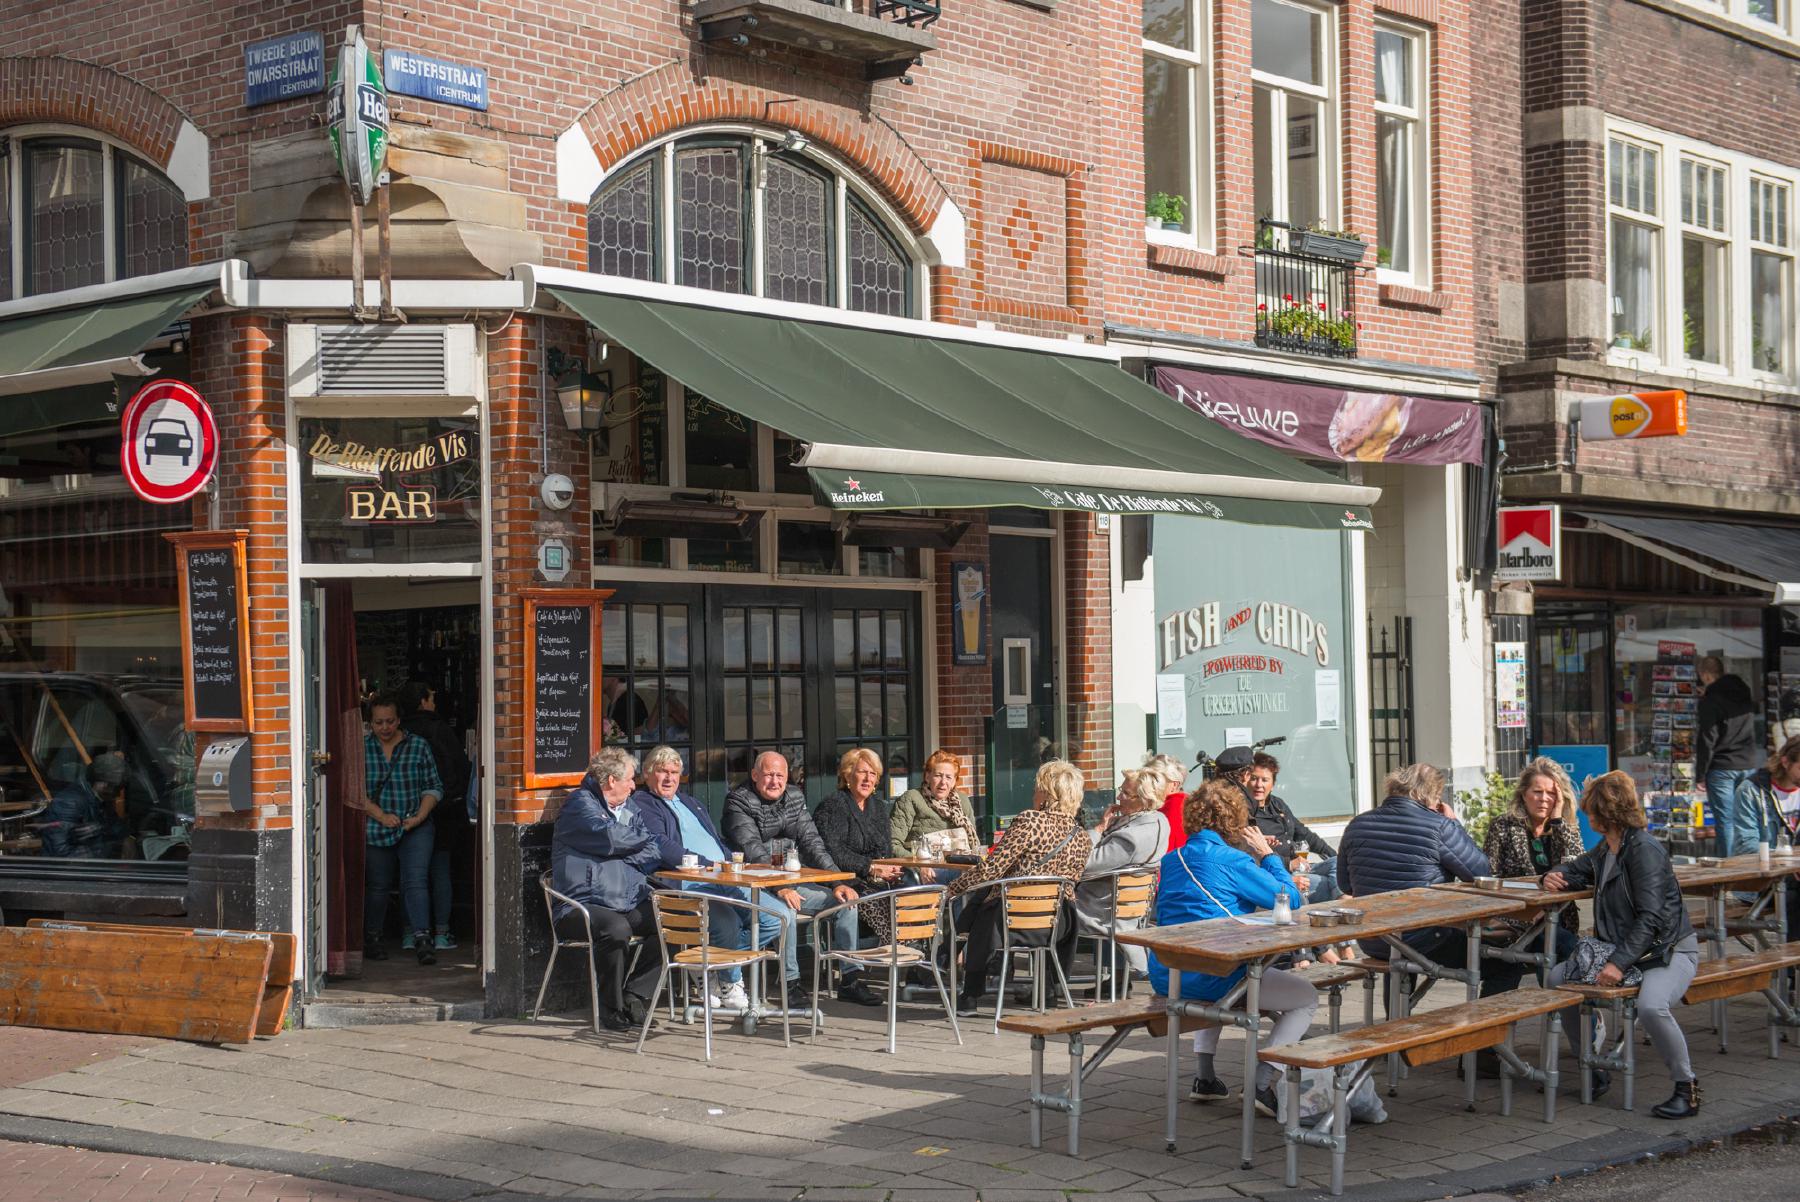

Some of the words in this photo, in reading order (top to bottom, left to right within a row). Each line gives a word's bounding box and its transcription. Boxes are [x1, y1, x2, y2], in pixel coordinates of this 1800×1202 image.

[248, 43, 286, 66] TWEEDE
[290, 36, 320, 56] BOOM
[248, 56, 320, 86] DWARSSTRAAT
[390, 54, 483, 89] WESTERSTRAAT
[1175, 384, 1299, 437] Nieuwe
[308, 433, 340, 459] De
[337, 441, 436, 472] Blaffende
[439, 433, 468, 463] Vis
[350, 491, 435, 520] BAR
[830, 490, 885, 503] Heineken
[1097, 493, 1124, 511] De
[1499, 546, 1553, 568] Marlboro
[1160, 600, 1222, 672] FISH
[1224, 607, 1253, 634] AND
[1256, 600, 1330, 668] CHIPS
[1202, 655, 1267, 679] POWERED
[1269, 658, 1285, 675] BY
